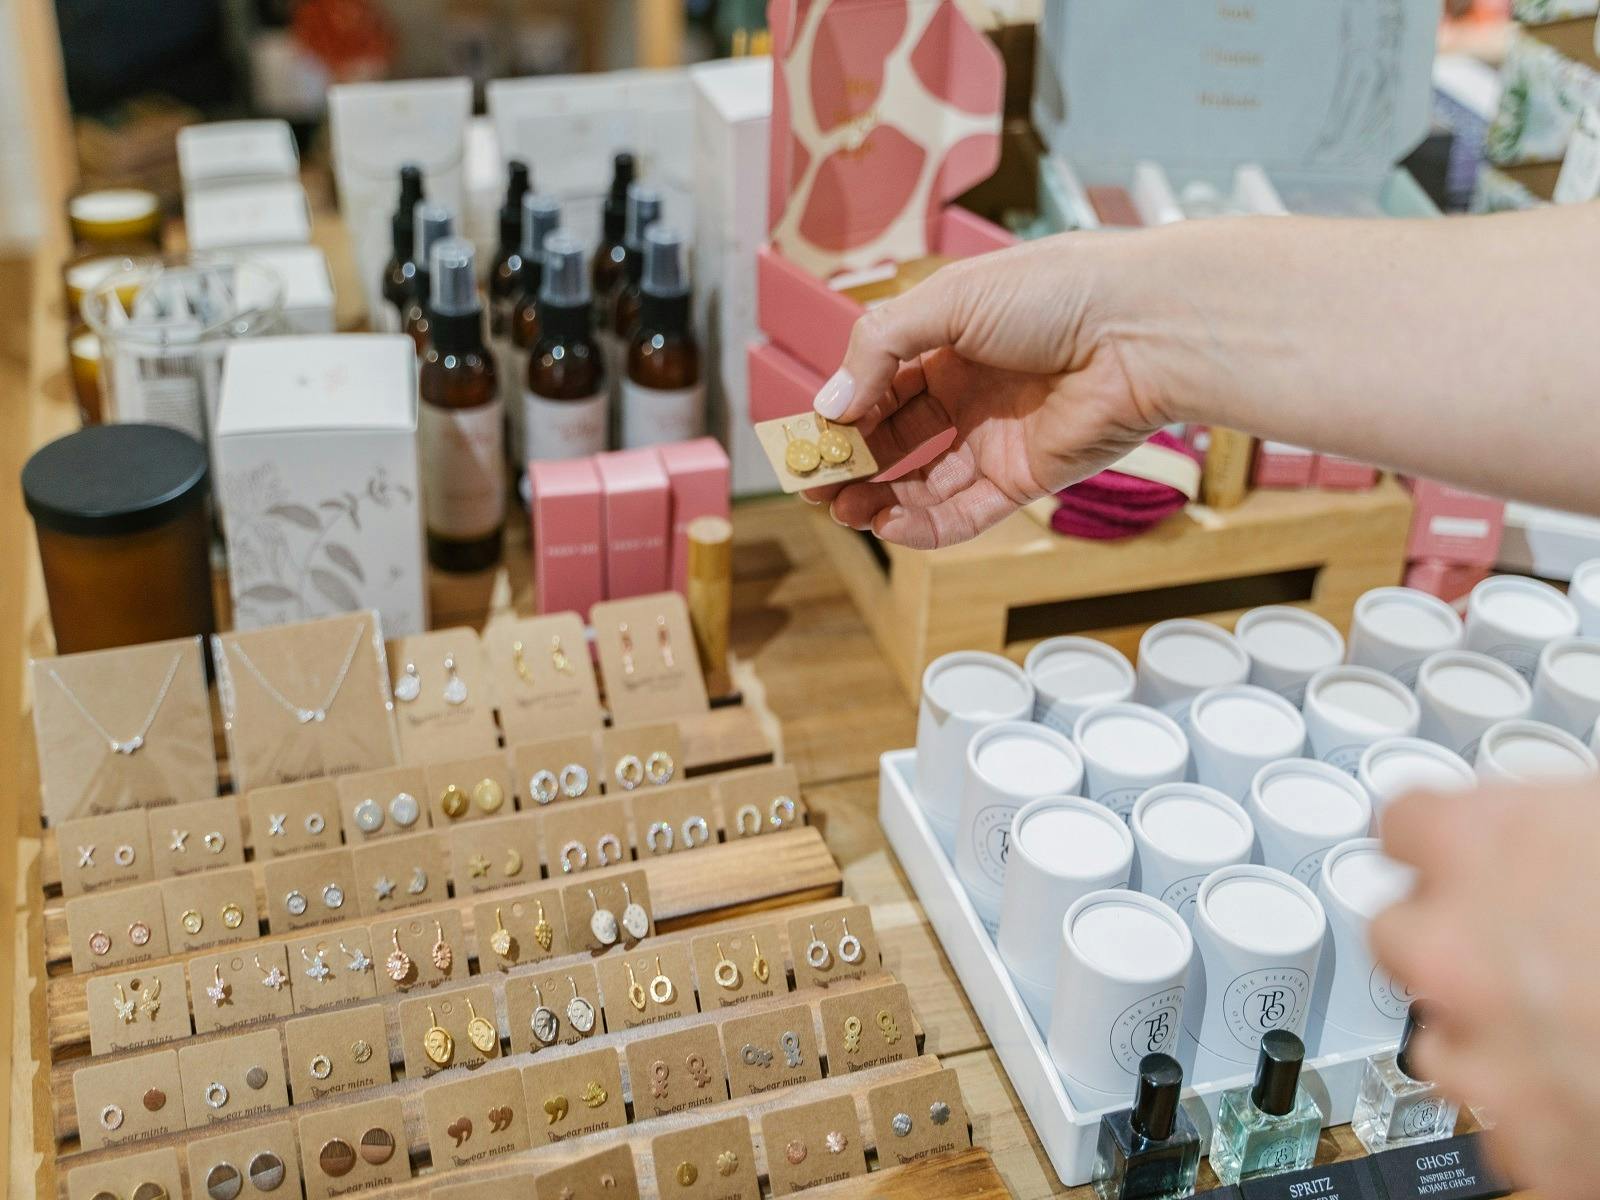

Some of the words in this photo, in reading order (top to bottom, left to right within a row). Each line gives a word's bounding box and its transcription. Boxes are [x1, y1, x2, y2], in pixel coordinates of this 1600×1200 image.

[751, 990, 773, 1000] mints
[658, 1011, 682, 1022] mints
[146, 1035, 173, 1045] mints
[879, 1053, 903, 1065] mints
[348, 1078, 374, 1088] mints
[783, 1076, 807, 1088] mints
[688, 1097, 713, 1109] mints
[245, 1104, 272, 1116] mints
[141, 1127, 169, 1138] mints
[583, 1122, 609, 1133] mints
[489, 1144, 515, 1155] mints
[930, 1143, 955, 1155] mints
[1416, 1151, 1461, 1170] GHOST
[825, 1172, 851, 1184] mints
[1420, 1171, 1455, 1184] INSPIRED
[1456, 1168, 1466, 1178] BY
[365, 1177, 393, 1188] mints
[1290, 1177, 1333, 1198] SPRITZ
[1418, 1181, 1448, 1195] MOJAVE
[1449, 1176, 1476, 1189] GHOST
